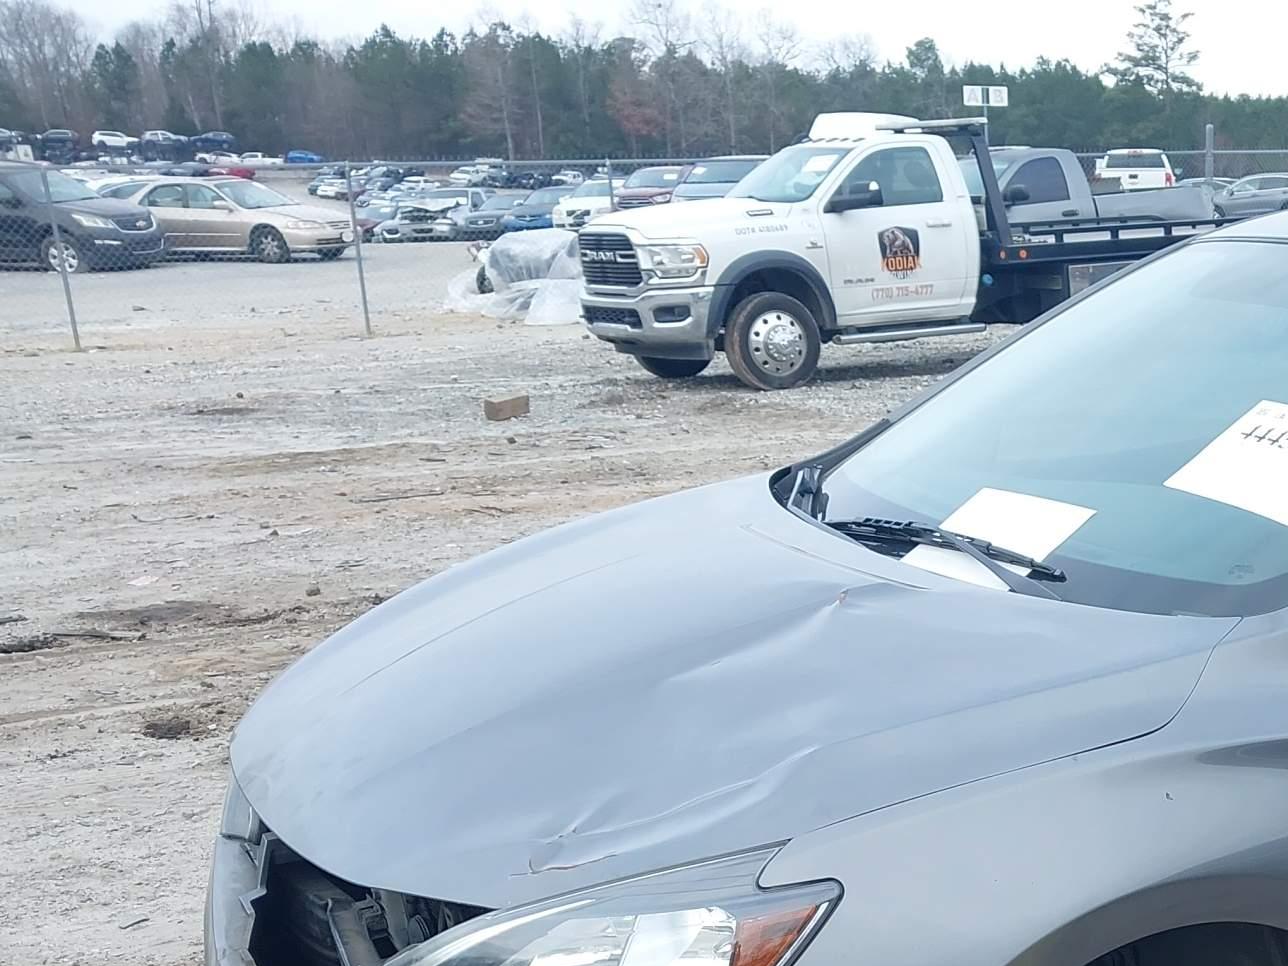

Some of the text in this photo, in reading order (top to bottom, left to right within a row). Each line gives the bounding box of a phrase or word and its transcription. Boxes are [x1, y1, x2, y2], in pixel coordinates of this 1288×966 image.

[967, 88, 1004, 104] A B
[588, 250, 616, 263] RAM
[881, 255, 922, 272] KODIAK
